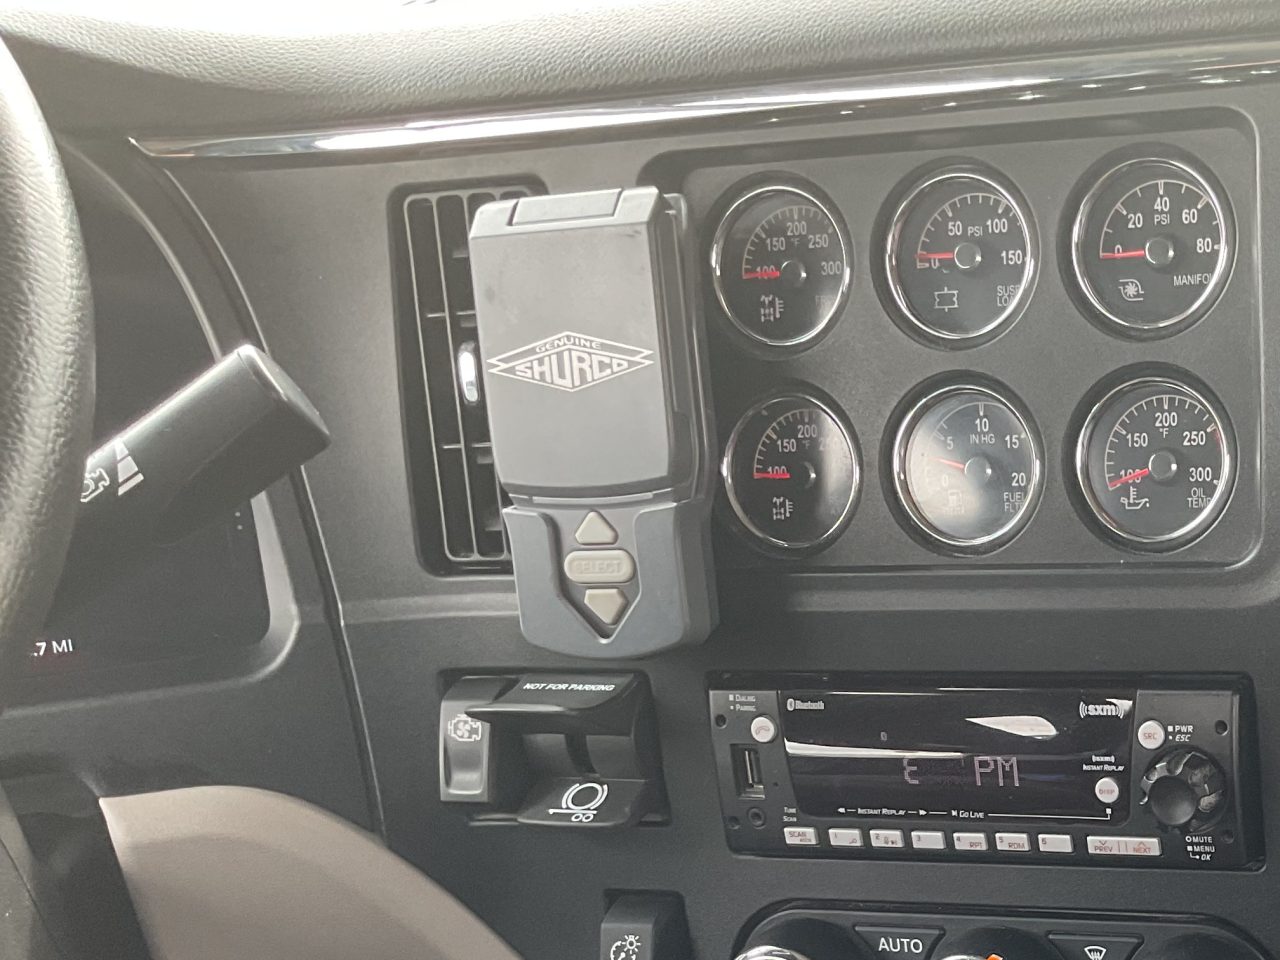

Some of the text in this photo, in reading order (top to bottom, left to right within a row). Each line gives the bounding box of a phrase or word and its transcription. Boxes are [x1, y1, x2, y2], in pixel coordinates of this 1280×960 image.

[1154, 197, 1170, 212] 40
[1127, 213, 1143, 229] 20
[1154, 214, 1170, 226] PSI
[1182, 208, 1198, 224] 60
[786, 221, 807, 236] 200
[948, 221, 962, 236] 50
[967, 226, 983, 237] PSI
[986, 218, 1008, 234] 100
[766, 237, 786, 252] 150
[808, 234, 829, 249] 250
[1196, 238, 1212, 253] 80
[1001, 250, 1023, 265] 150
[821, 261, 842, 276] 300
[1173, 273, 1213, 287] MANIFO
[535, 334, 601, 353] GENUINE
[515, 349, 629, 388] SHURCO
[975, 418, 989, 432] 10
[1155, 412, 1178, 427] 200
[797, 424, 817, 438] 200
[1183, 431, 1206, 446] 250
[776, 439, 797, 453] 150
[946, 436, 954, 449] 5
[970, 434, 996, 444] IN HG
[1004, 435, 1020, 449] 15
[1126, 433, 1148, 448] 150
[1011, 472, 1026, 487] 20
[1189, 467, 1212, 482] 300
[1191, 487, 1206, 498] OIL
[52, 639, 73, 653] MI
[1175, 725, 1194, 733] PWR
[1175, 734, 1190, 742] ESC
[973, 756, 1020, 787] PM
[1194, 845, 1215, 853] MENU
[878, 937, 923, 953] AUTO
